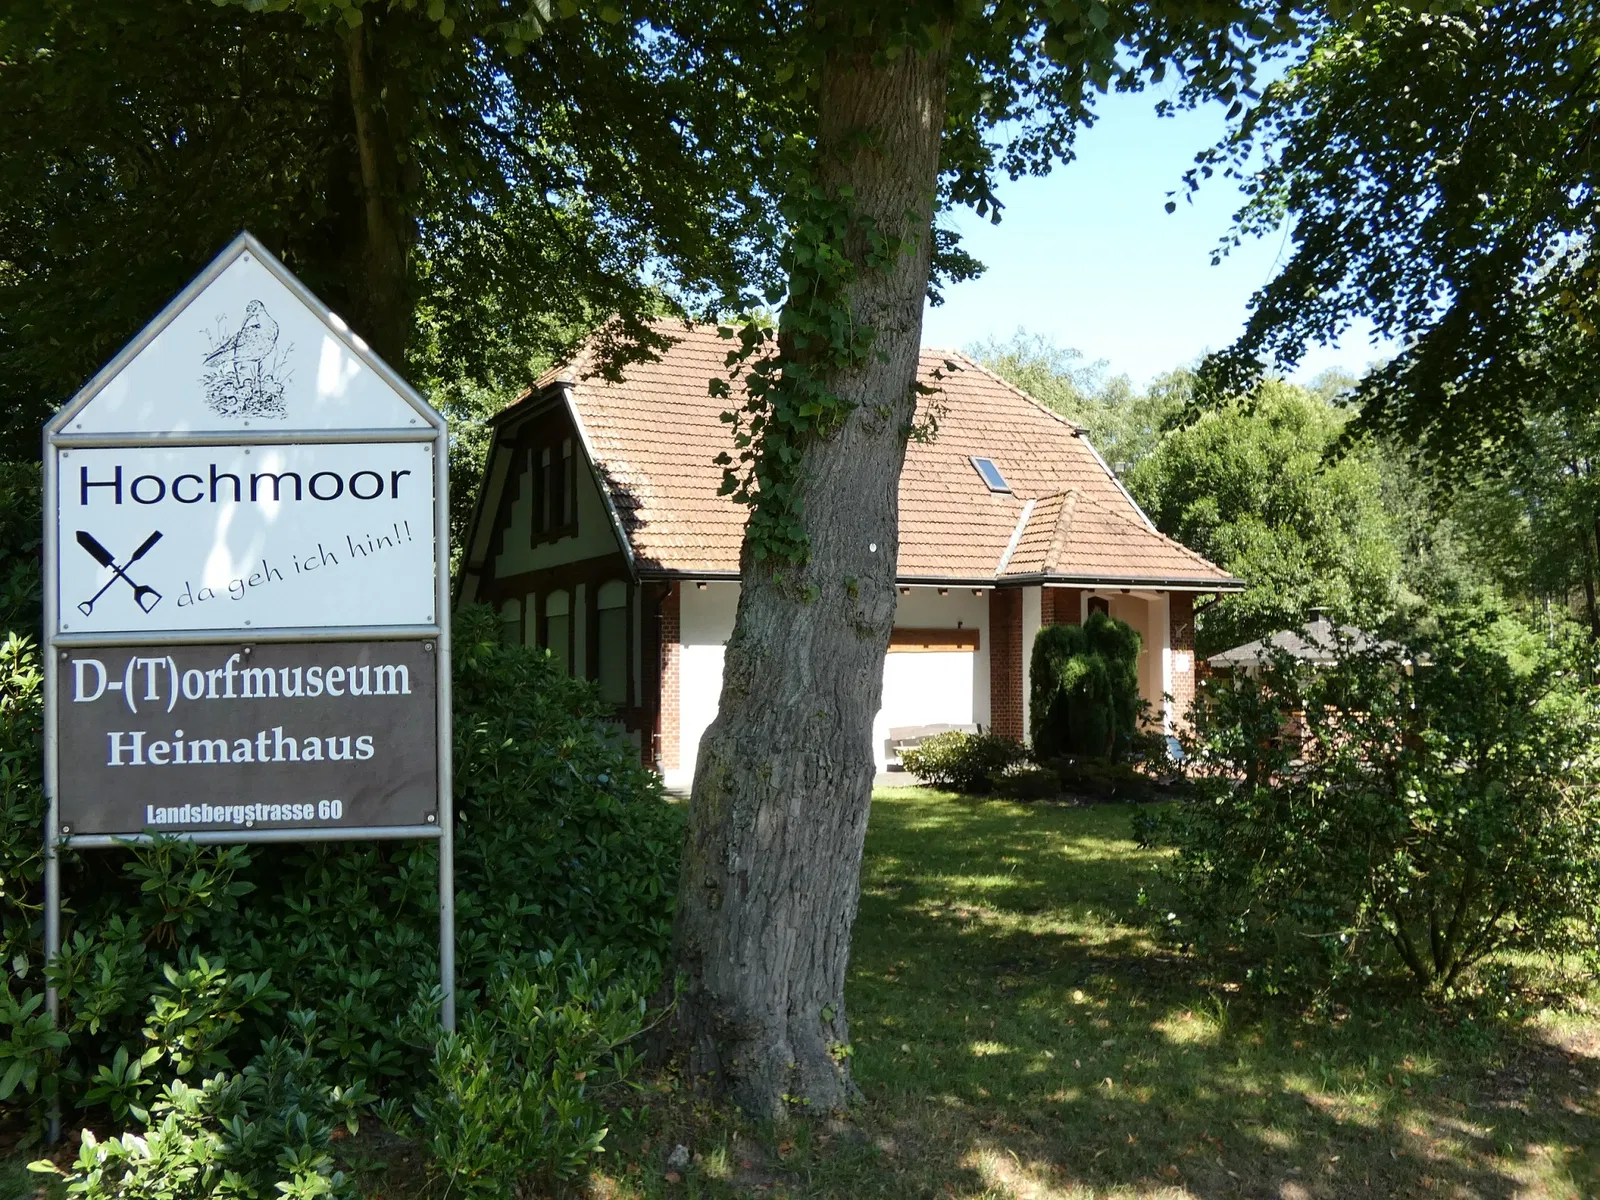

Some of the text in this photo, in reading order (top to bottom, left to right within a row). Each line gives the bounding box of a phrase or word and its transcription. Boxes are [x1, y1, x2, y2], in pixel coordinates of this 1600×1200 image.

[80, 464, 411, 505] Hochmoor
[176, 520, 414, 607] da geh ich hin!!
[71, 653, 412, 714] D-(T)orfmuseum
[106, 726, 376, 766] Heimathaus
[146, 799, 343, 826] Landsbergstrasse 60
